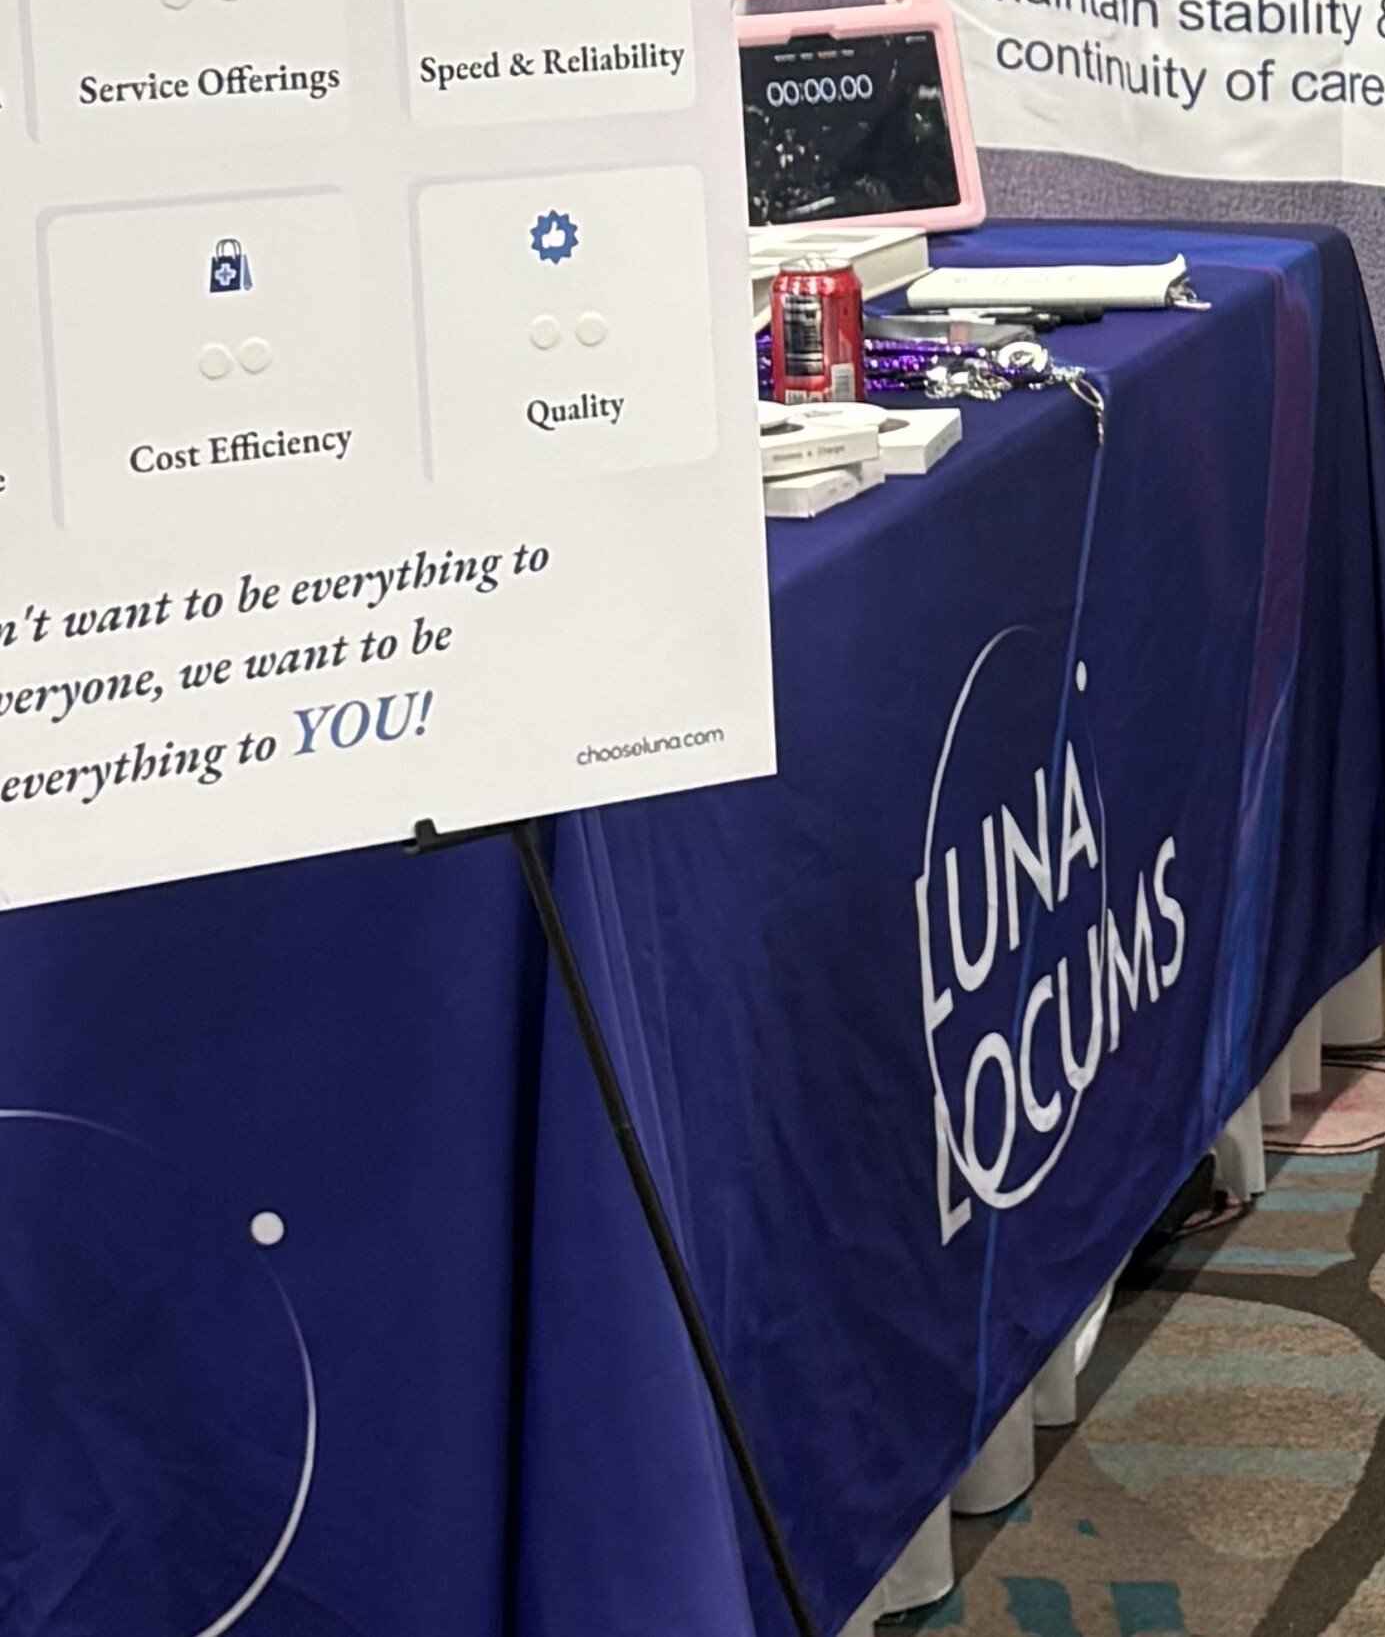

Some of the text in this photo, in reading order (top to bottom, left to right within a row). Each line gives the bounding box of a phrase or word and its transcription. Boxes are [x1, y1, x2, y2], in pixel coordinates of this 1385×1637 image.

[79, 64, 341, 104] Service Offerings
[419, 42, 686, 91] Speed & Reliability
[996, 33, 1207, 109] continuity
[1225, 62, 1276, 104] of
[129, 429, 353, 474] Cost Efficiency
[526, 393, 625, 431] Quality
[0, 543, 550, 647] n't want to be everything to
[0, 616, 453, 724] veryone, we want to be
[0, 689, 434, 805] everything to YOU!
[915, 738, 1099, 1031] LUNA
[933, 834, 1187, 1246] LOCUMS
